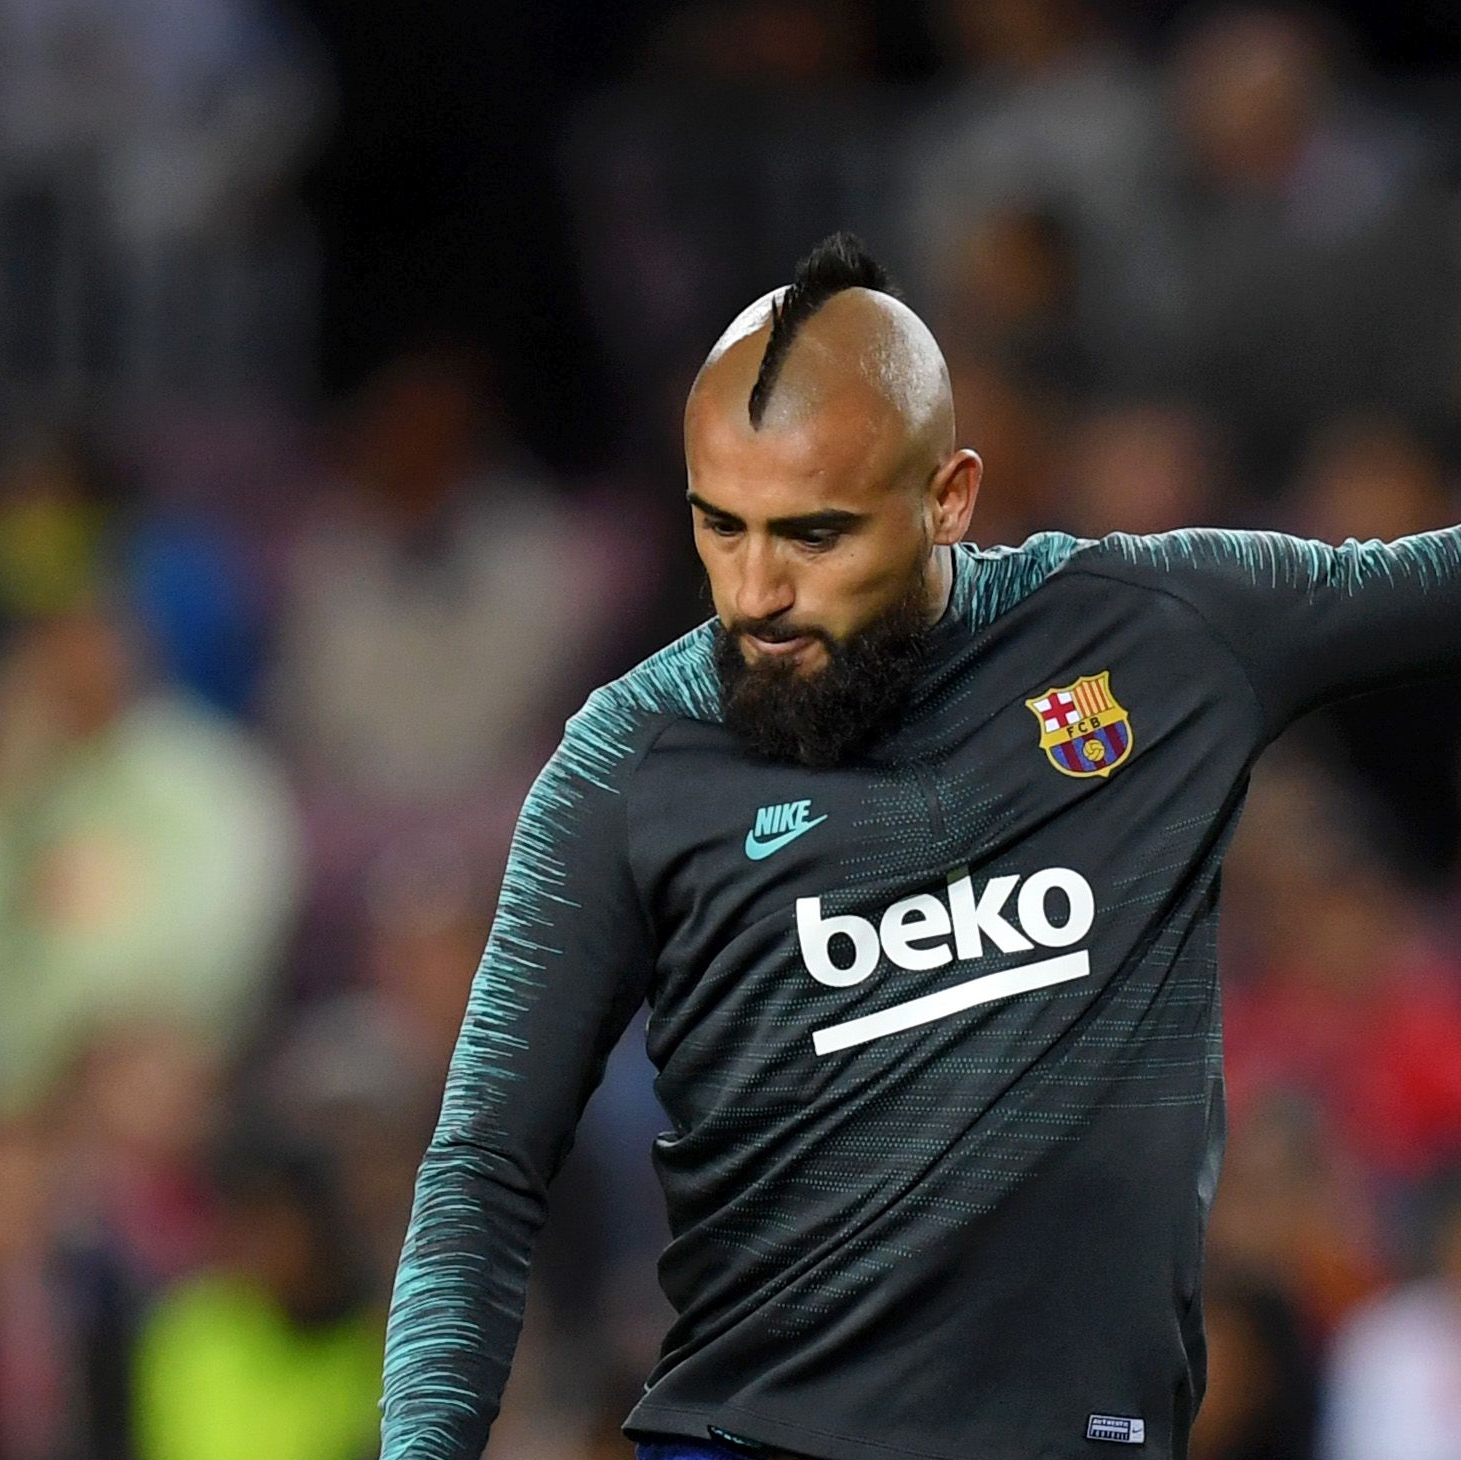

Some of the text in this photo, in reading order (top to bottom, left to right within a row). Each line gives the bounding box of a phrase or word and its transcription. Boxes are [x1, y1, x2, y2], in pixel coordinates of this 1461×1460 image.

[1066, 717, 1101, 739] FCB
[754, 799, 812, 838] NIKE
[796, 866, 1095, 988] beko
